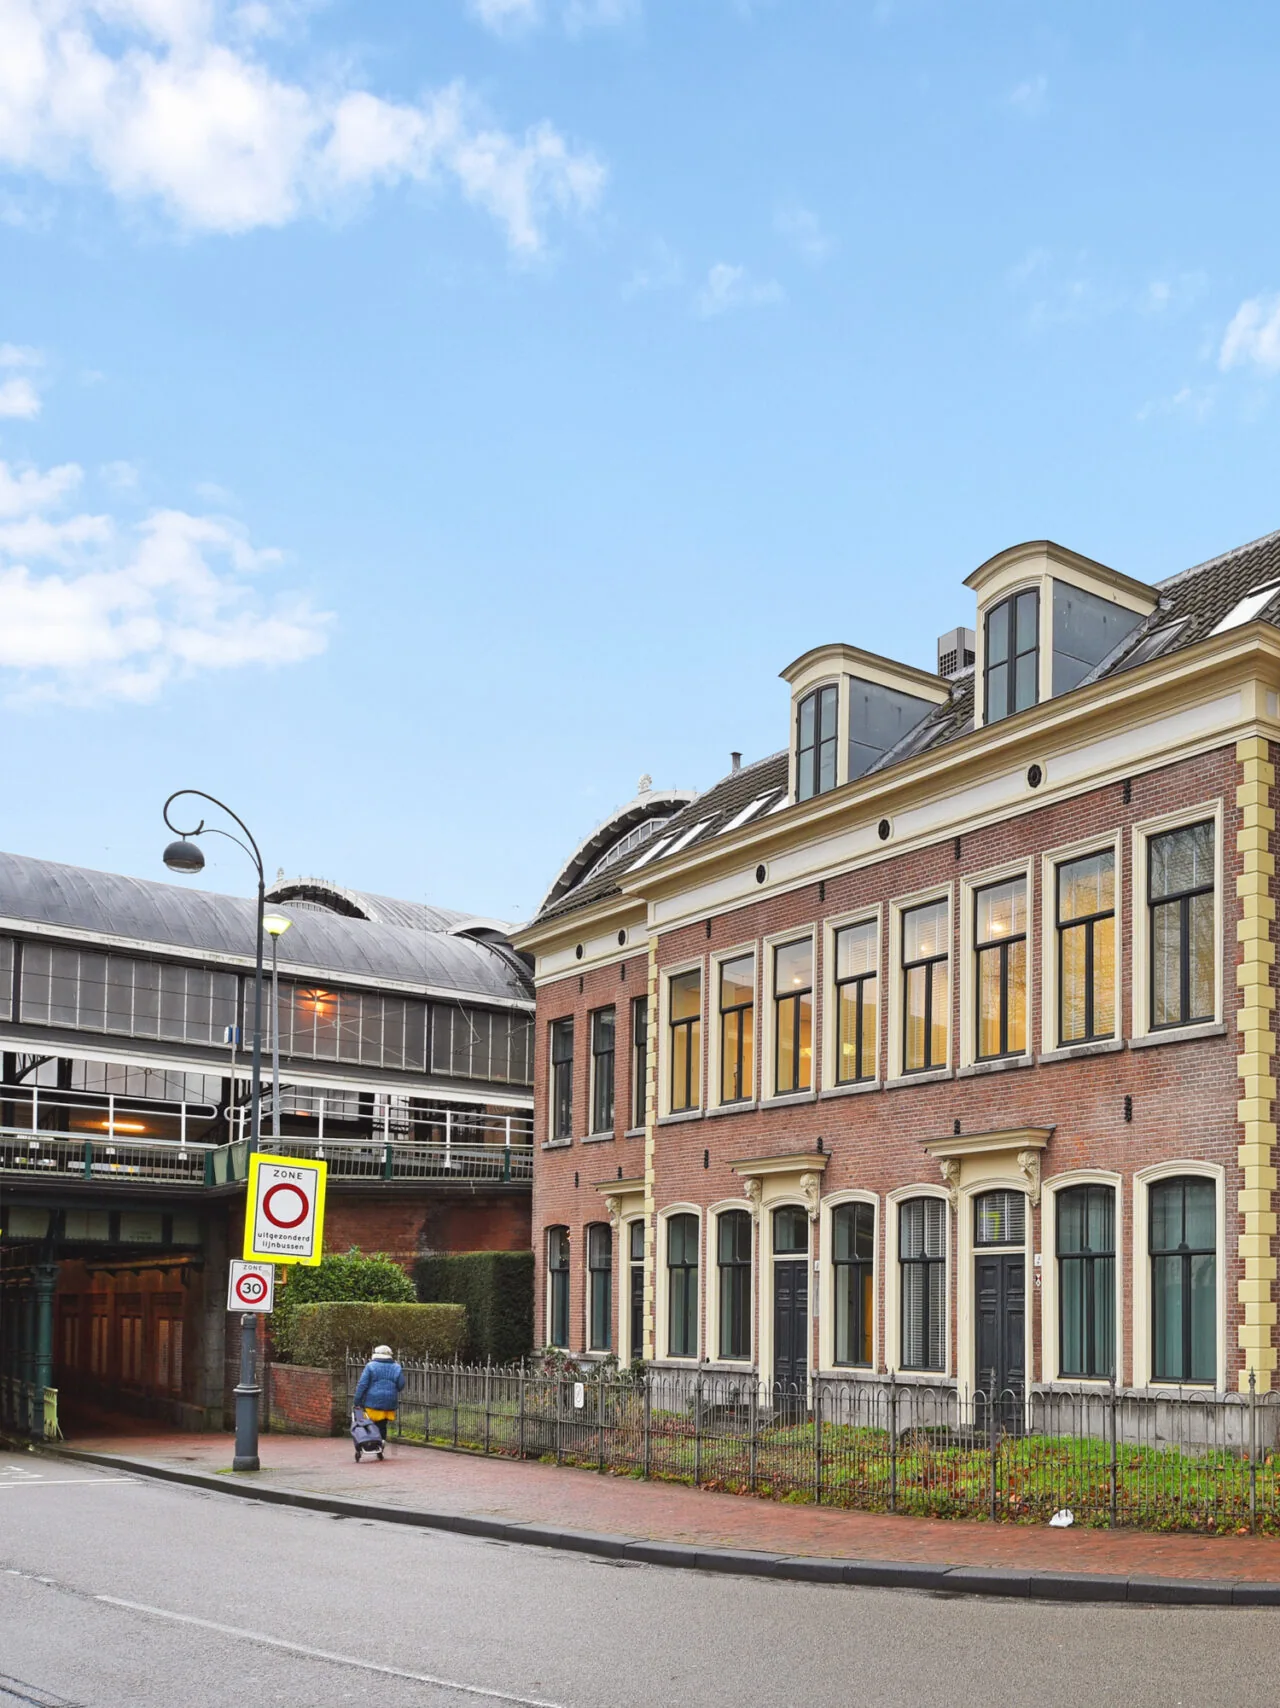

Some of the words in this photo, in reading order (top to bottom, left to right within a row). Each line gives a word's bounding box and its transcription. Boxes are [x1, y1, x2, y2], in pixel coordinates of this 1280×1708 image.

[273, 1169, 303, 1180] ZONE
[257, 1232, 310, 1242] uitgezonderd
[262, 1241, 304, 1250] lijnbussen
[242, 1282, 262, 1295] 30
